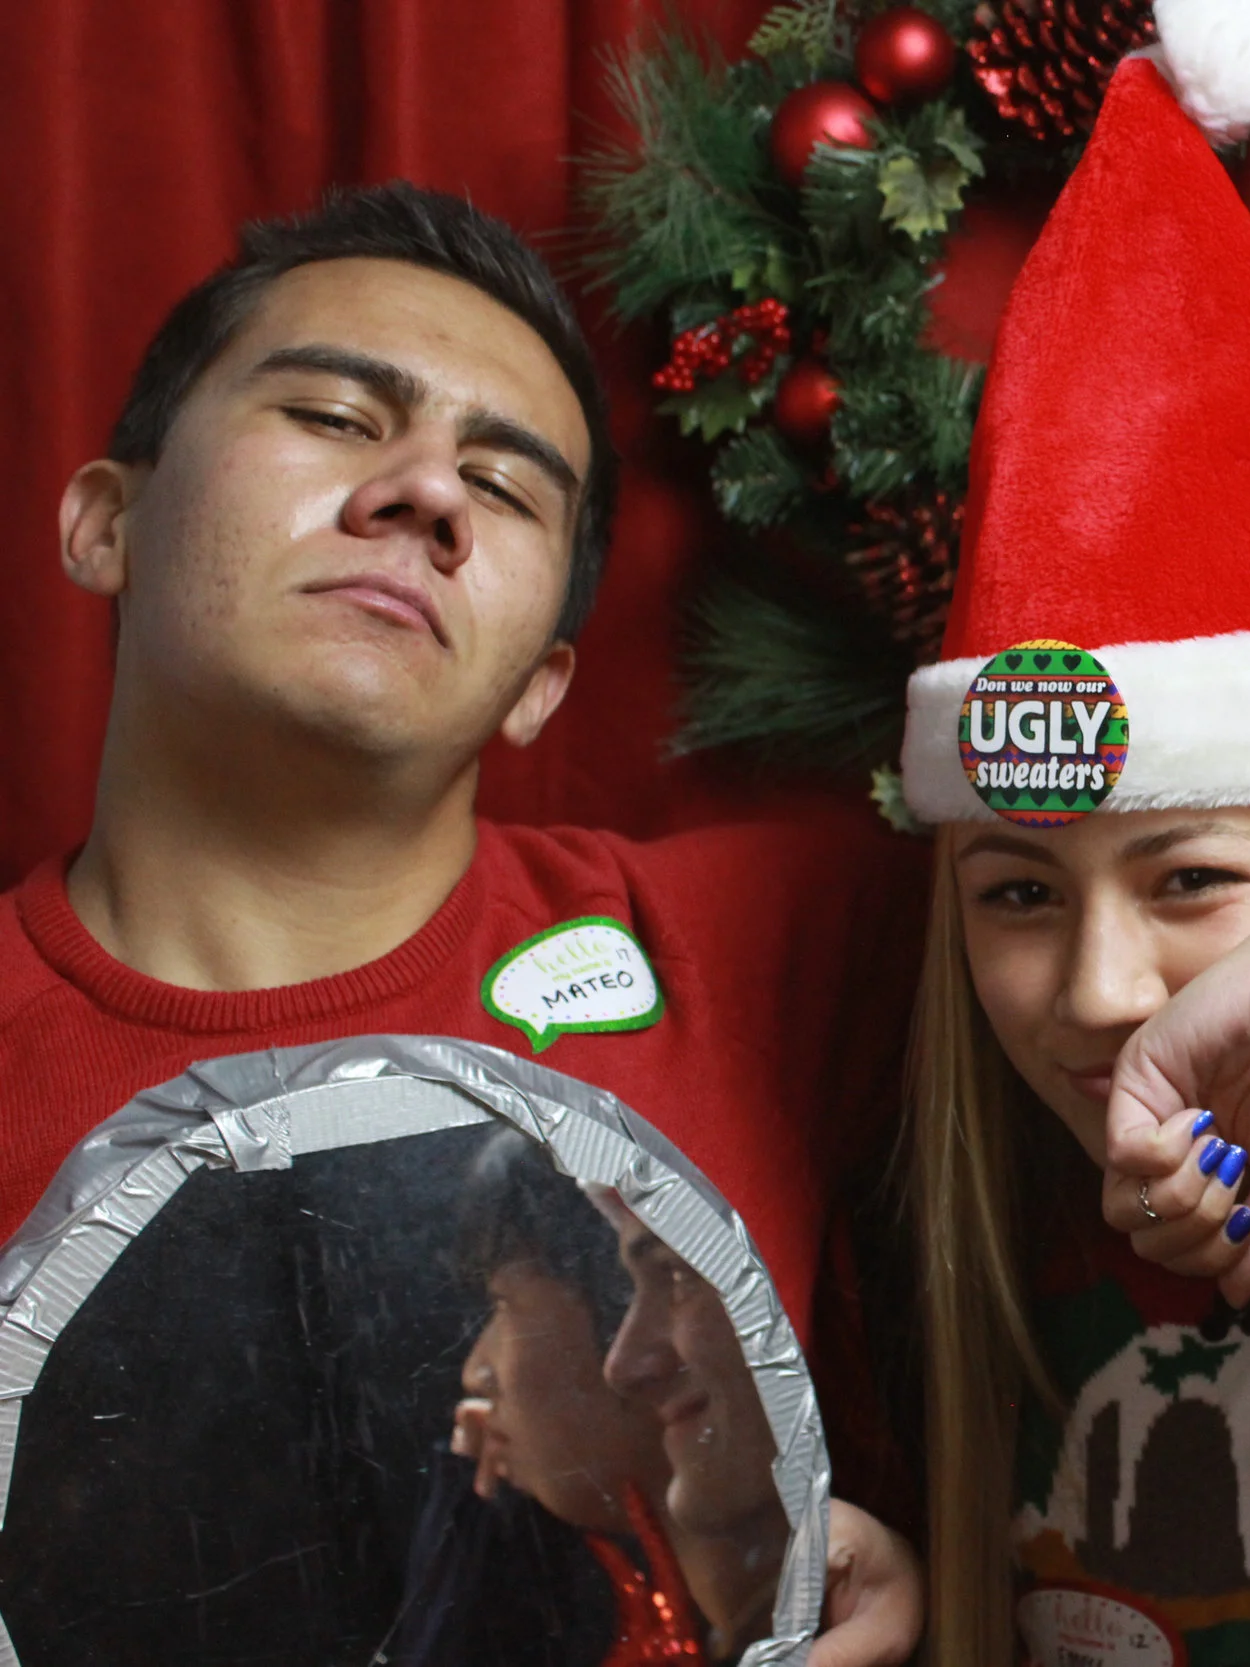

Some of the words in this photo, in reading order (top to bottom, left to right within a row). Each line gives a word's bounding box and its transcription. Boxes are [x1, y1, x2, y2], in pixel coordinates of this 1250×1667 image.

[976, 677, 1006, 693] Don
[1010, 681, 1033, 693] we
[1037, 681, 1073, 693] now
[1075, 681, 1107, 693] our
[969, 699, 1111, 755] UGLY
[976, 756, 1105, 790] sweaters
[541, 970, 635, 1009] MATEO
